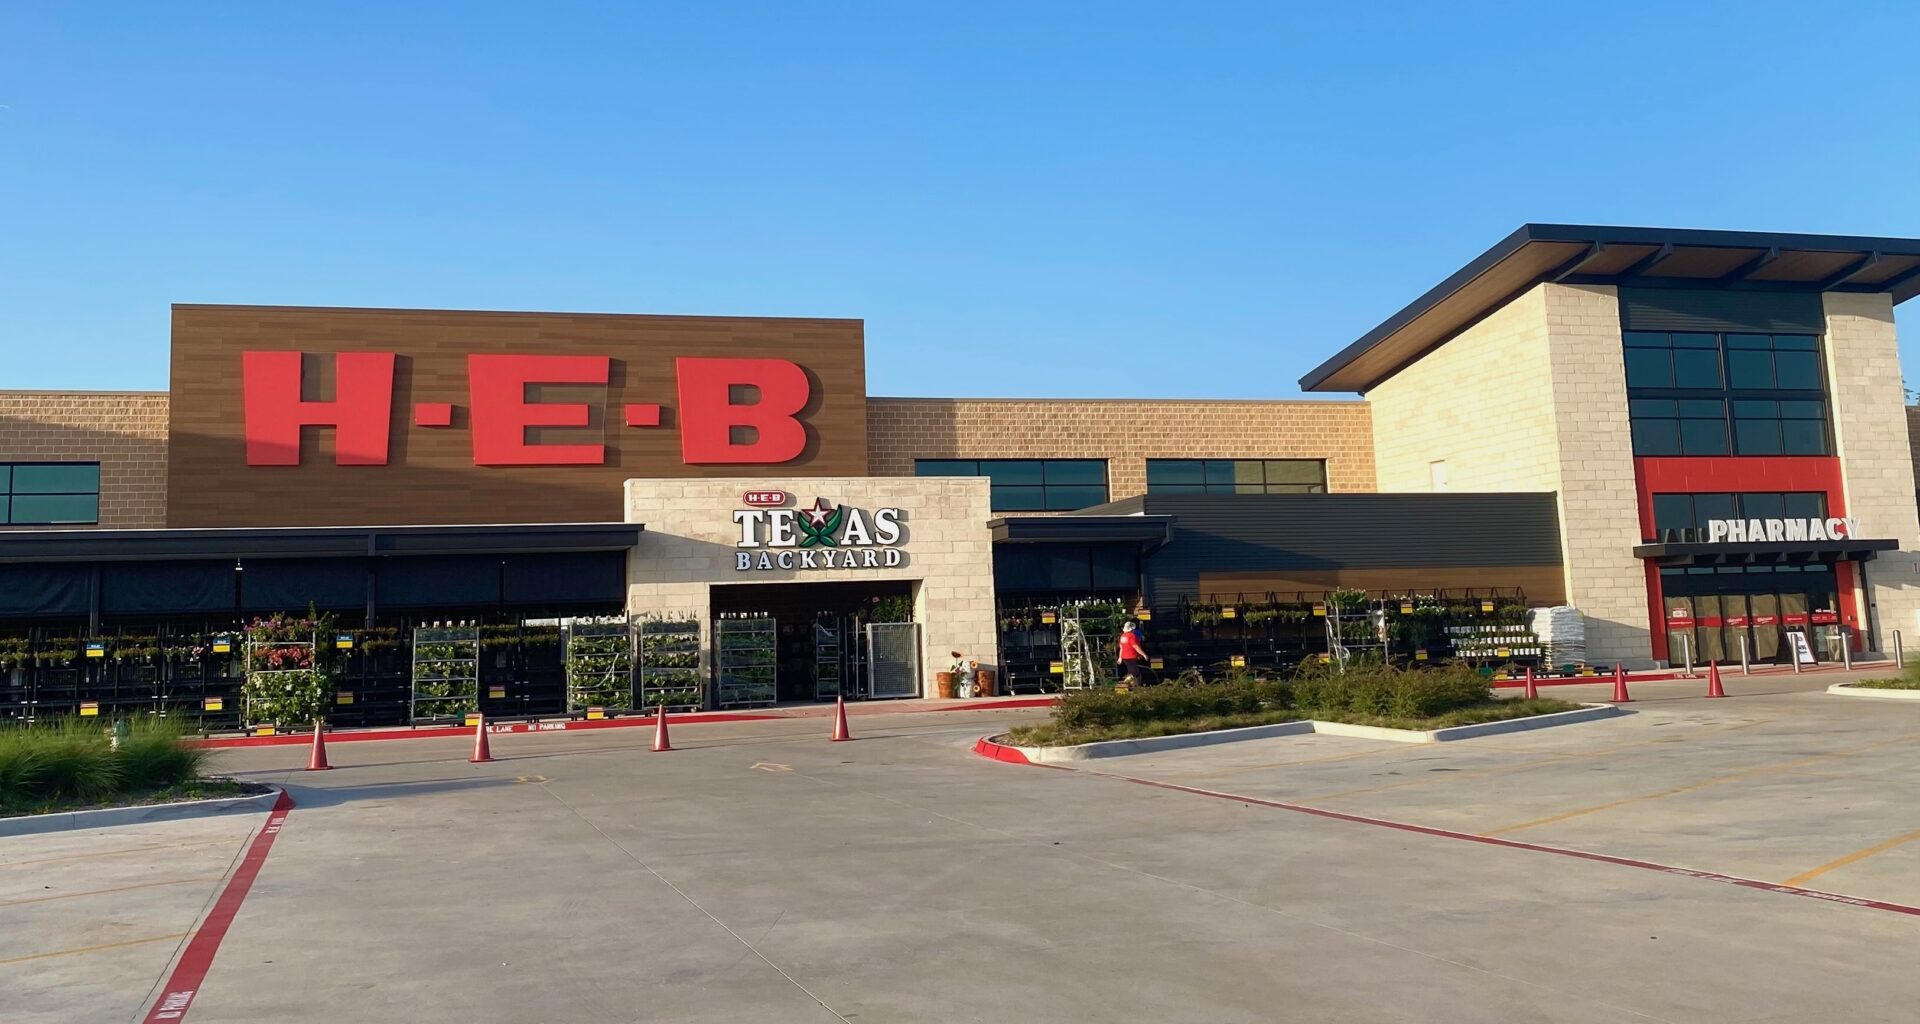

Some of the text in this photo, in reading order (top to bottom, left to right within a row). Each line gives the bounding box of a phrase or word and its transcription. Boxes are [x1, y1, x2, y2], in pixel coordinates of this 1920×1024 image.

[733, 498, 901, 548] TEXAS
[1708, 517, 1861, 543] PHARMACY
[735, 549, 902, 571] BACKYARD
